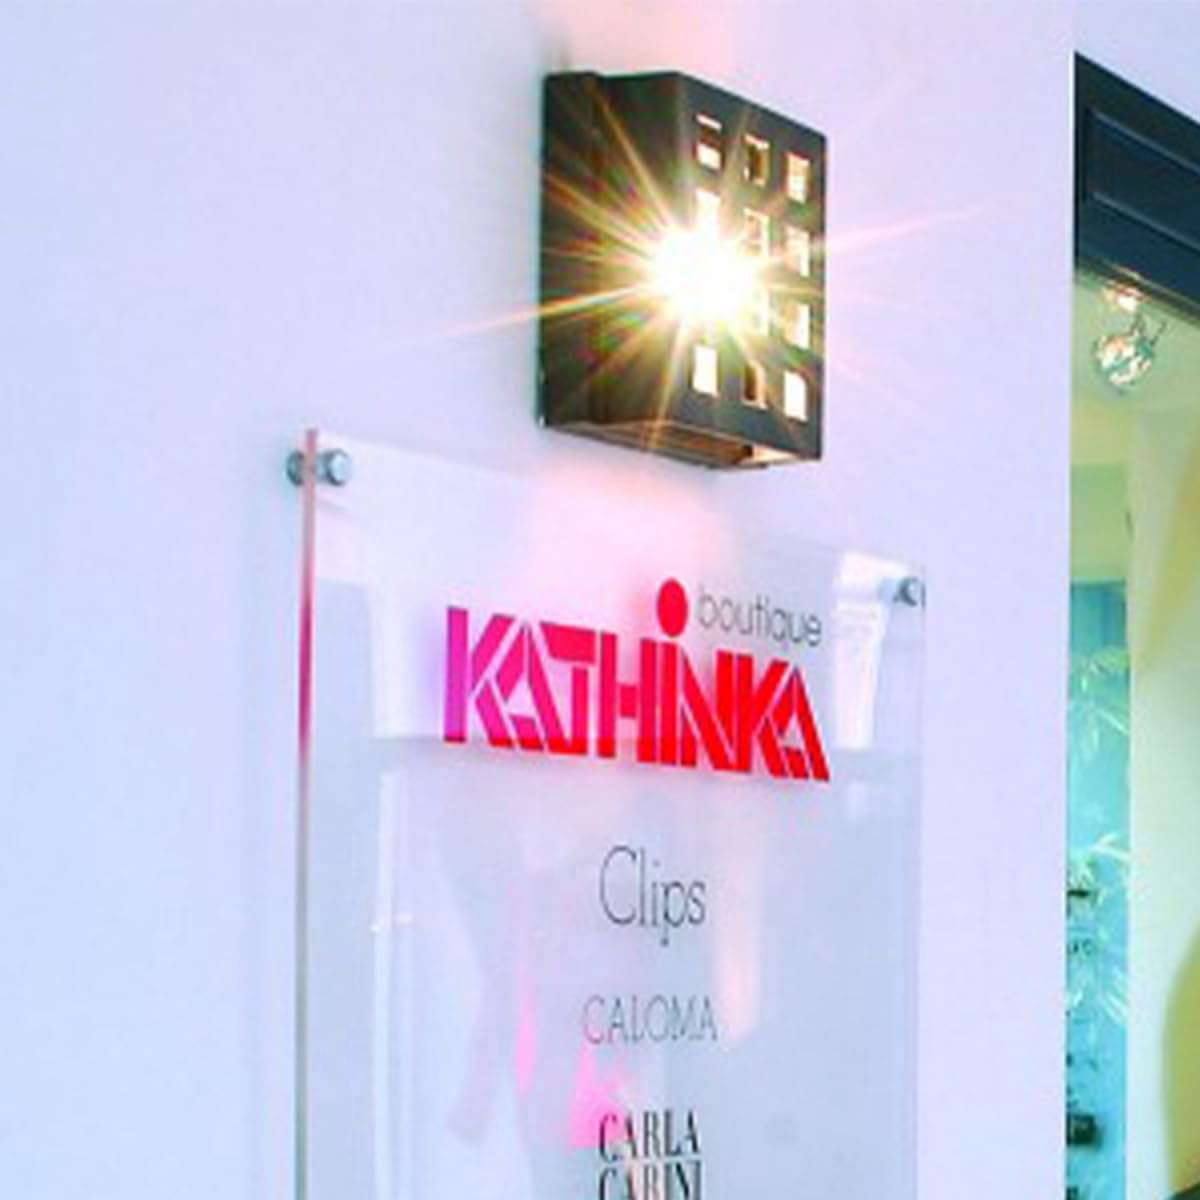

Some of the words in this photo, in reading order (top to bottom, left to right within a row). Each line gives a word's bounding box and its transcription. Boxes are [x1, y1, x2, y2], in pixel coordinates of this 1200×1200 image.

[698, 583, 822, 651] boutique
[443, 578, 831, 782] KATHINKA
[600, 845, 706, 947] Clips
[581, 994, 718, 1044] CALOMA
[598, 1108, 701, 1165] CARLA
